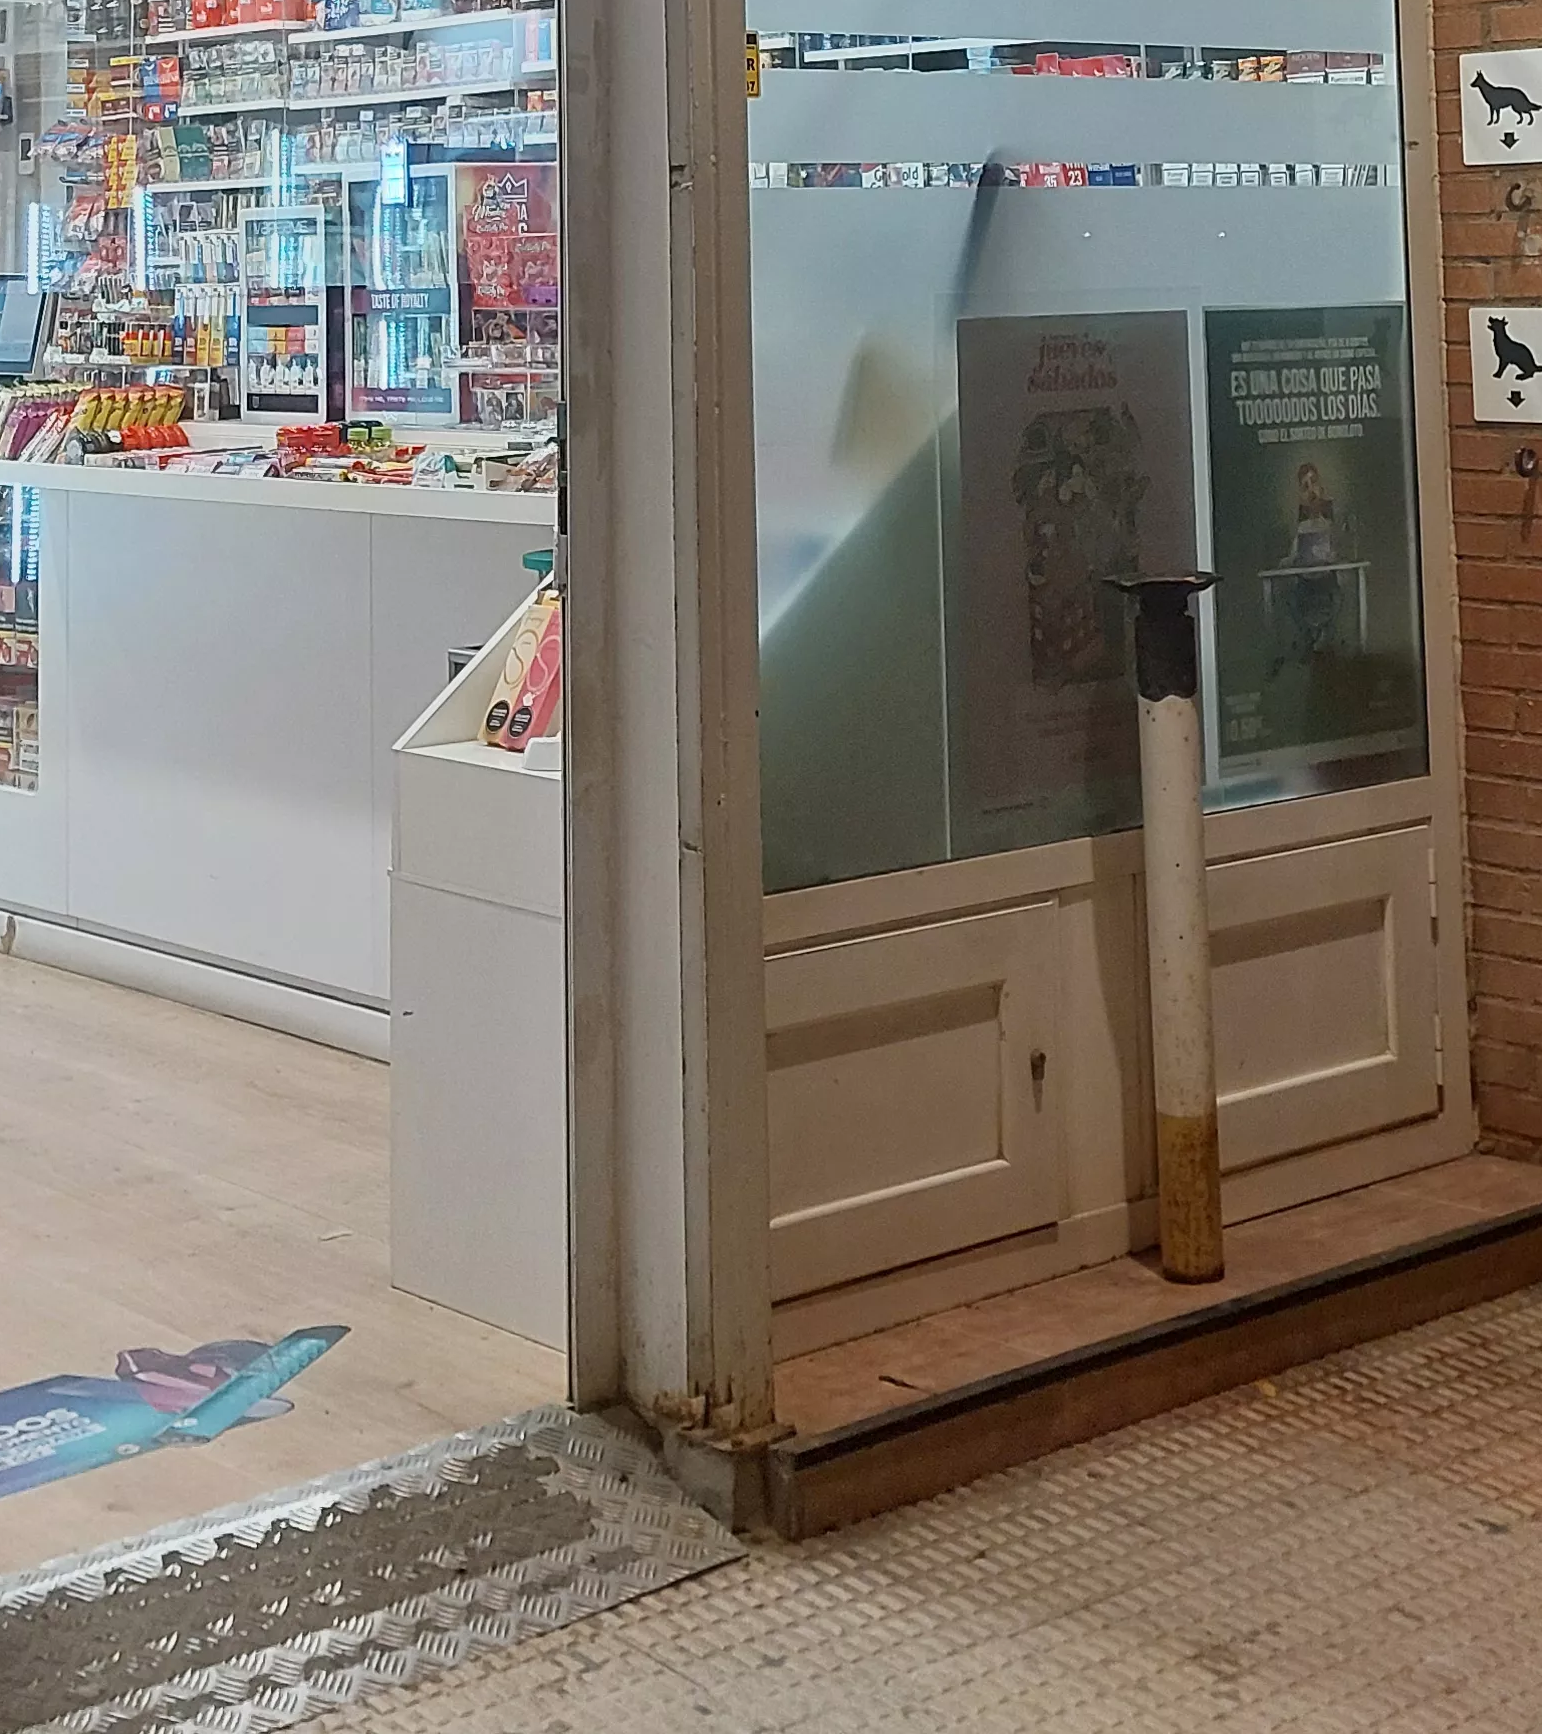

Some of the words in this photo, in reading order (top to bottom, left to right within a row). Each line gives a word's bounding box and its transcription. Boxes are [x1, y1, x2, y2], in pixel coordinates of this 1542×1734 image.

[1067, 170, 1083, 187] 23
[371, 294, 391, 309] TASTE
[391, 293, 400, 309] OF
[1231, 370, 1247, 397] ES
[1250, 370, 1279, 396] UNA
[1281, 368, 1318, 394] COSA
[1320, 366, 1347, 394] QUE
[1350, 364, 1382, 393] PASA
[1320, 394, 1346, 421] LOS
